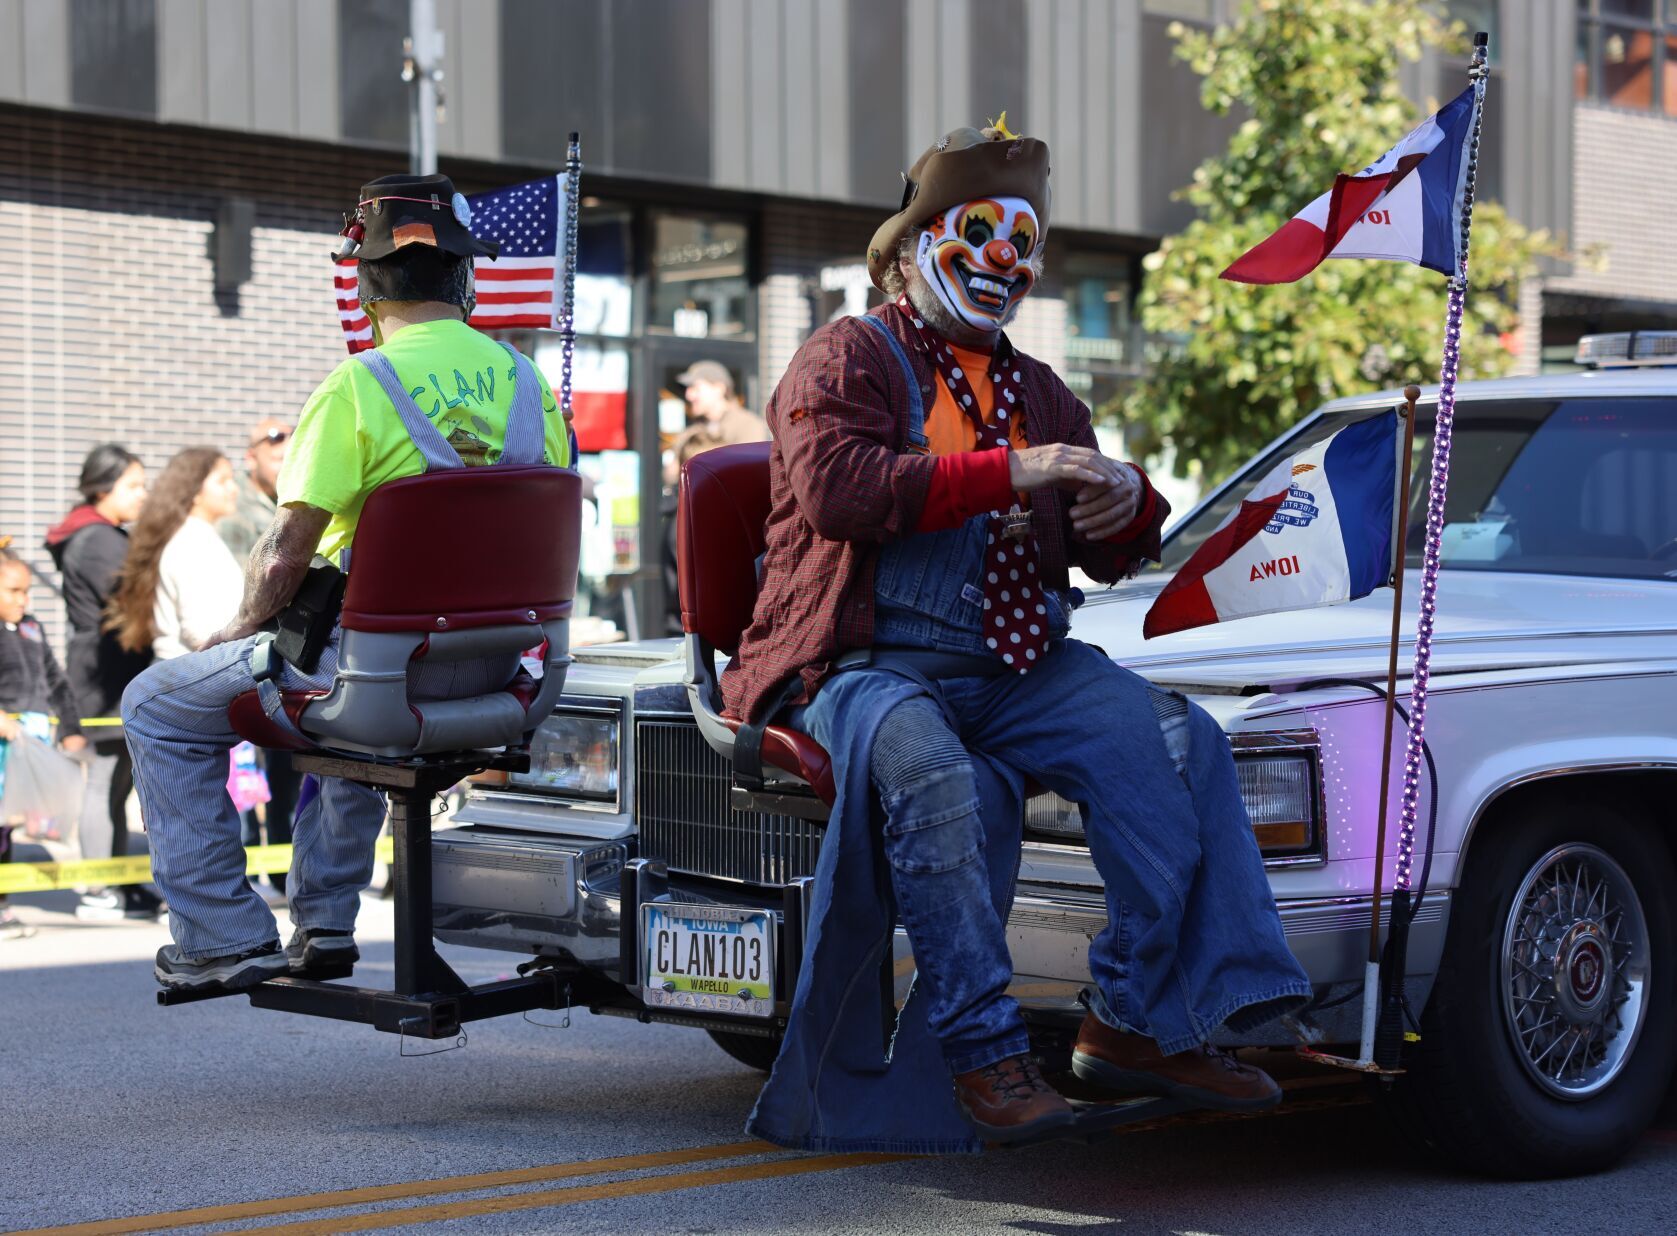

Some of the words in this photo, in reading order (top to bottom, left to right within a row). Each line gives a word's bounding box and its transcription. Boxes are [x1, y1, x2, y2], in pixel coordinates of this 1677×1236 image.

[410, 366, 494, 418] CLAN
[692, 920, 729, 932] IOWA
[657, 930, 761, 981] CLAN103
[690, 979, 729, 993] WAPELLO
[666, 992, 748, 1012] KAABA
